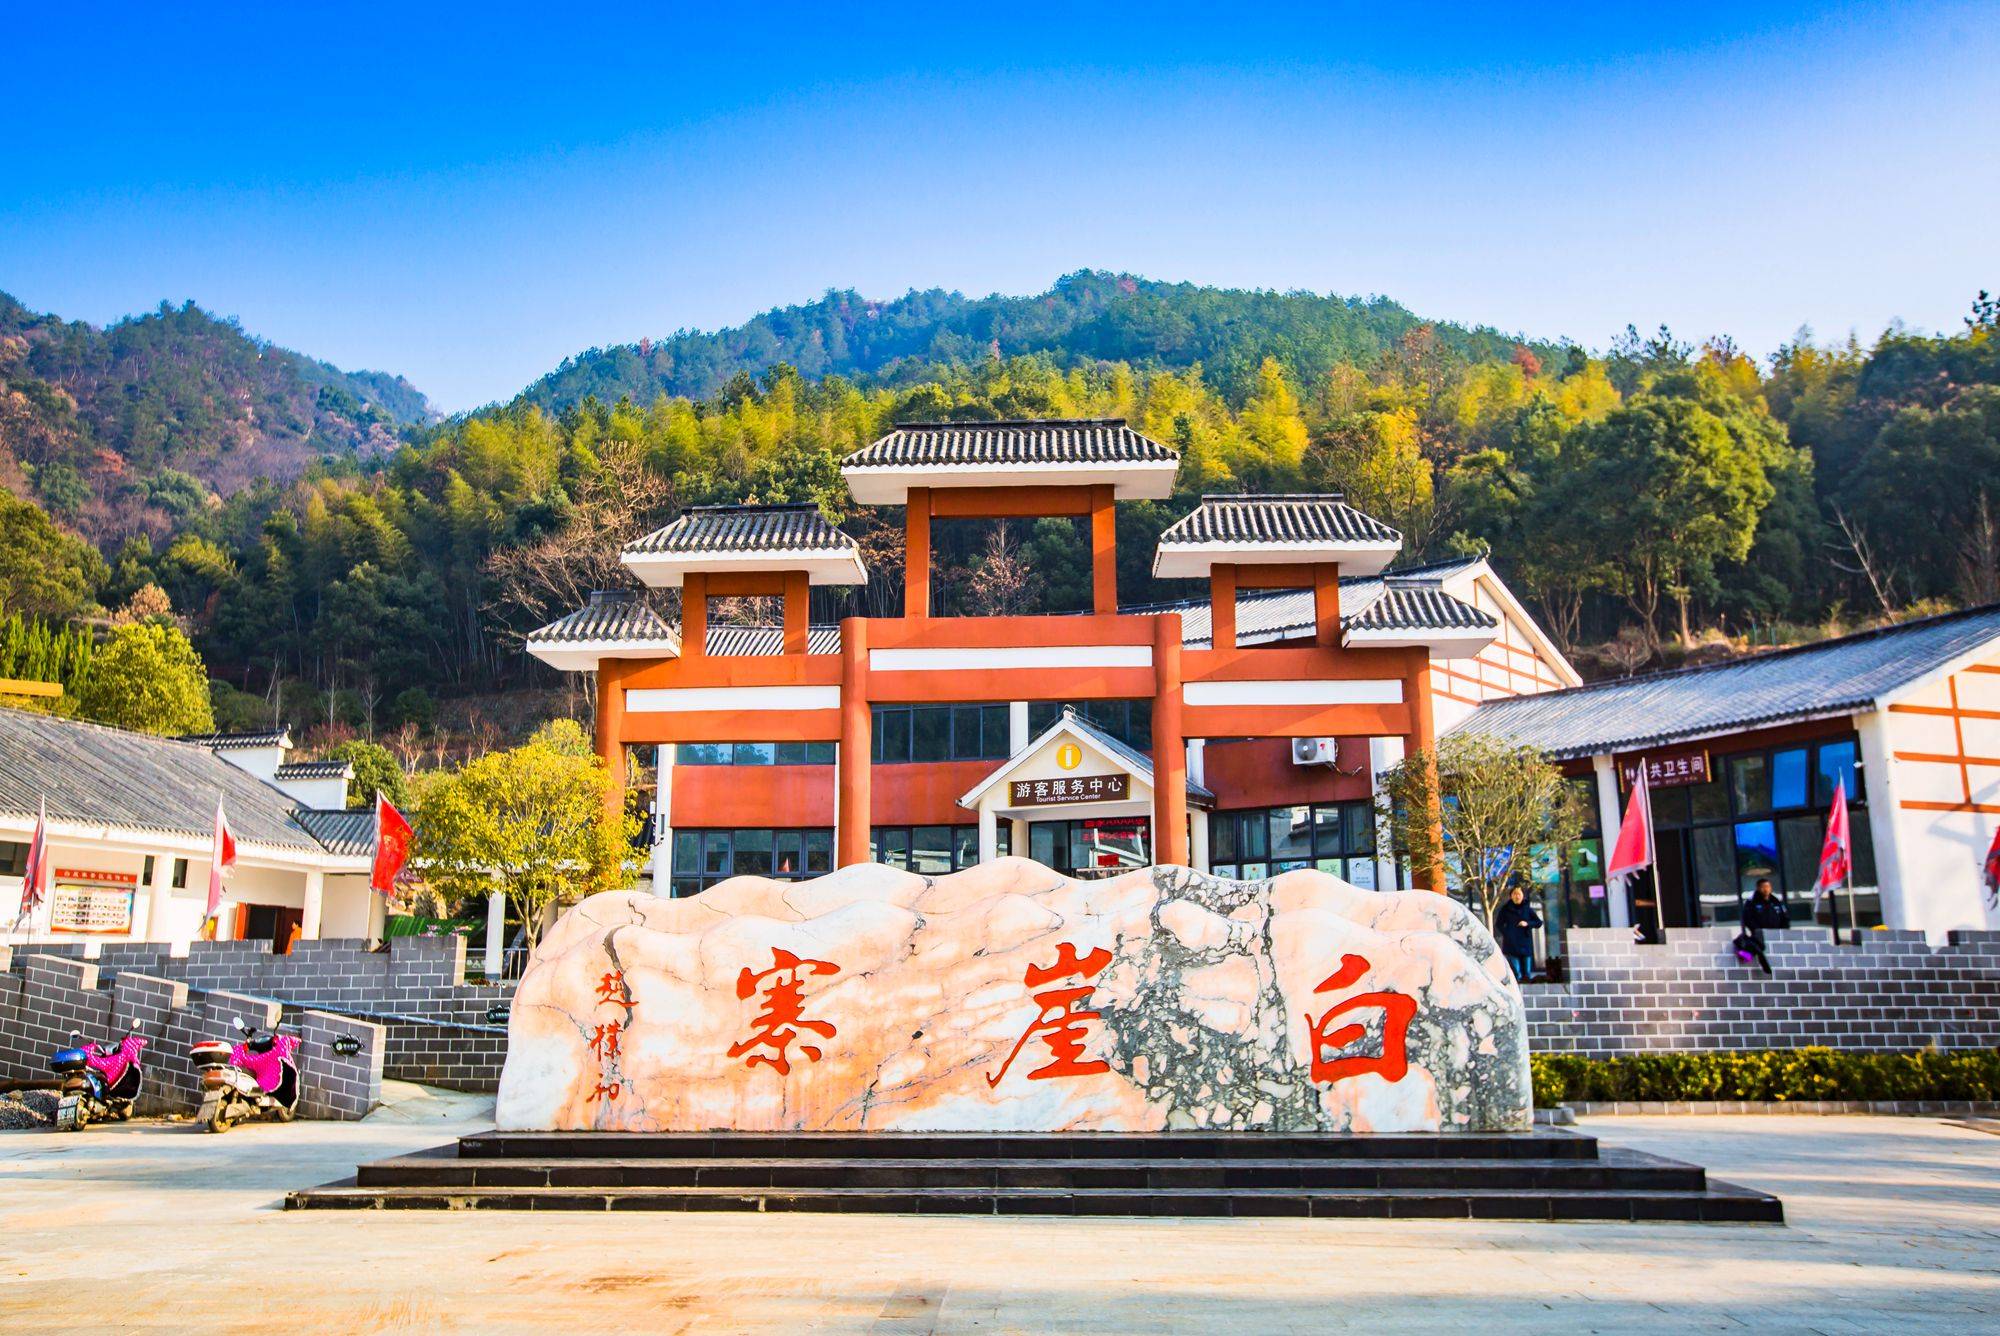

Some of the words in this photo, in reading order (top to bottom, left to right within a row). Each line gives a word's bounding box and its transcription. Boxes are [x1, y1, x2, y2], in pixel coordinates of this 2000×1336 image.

[1637, 756, 1704, 780] 共卫生间
[1016, 777, 1122, 798] 游客服务中心
[1036, 794, 1056, 803] Tourist
[1057, 794, 1079, 802] Service
[1080, 793, 1101, 801] Center
